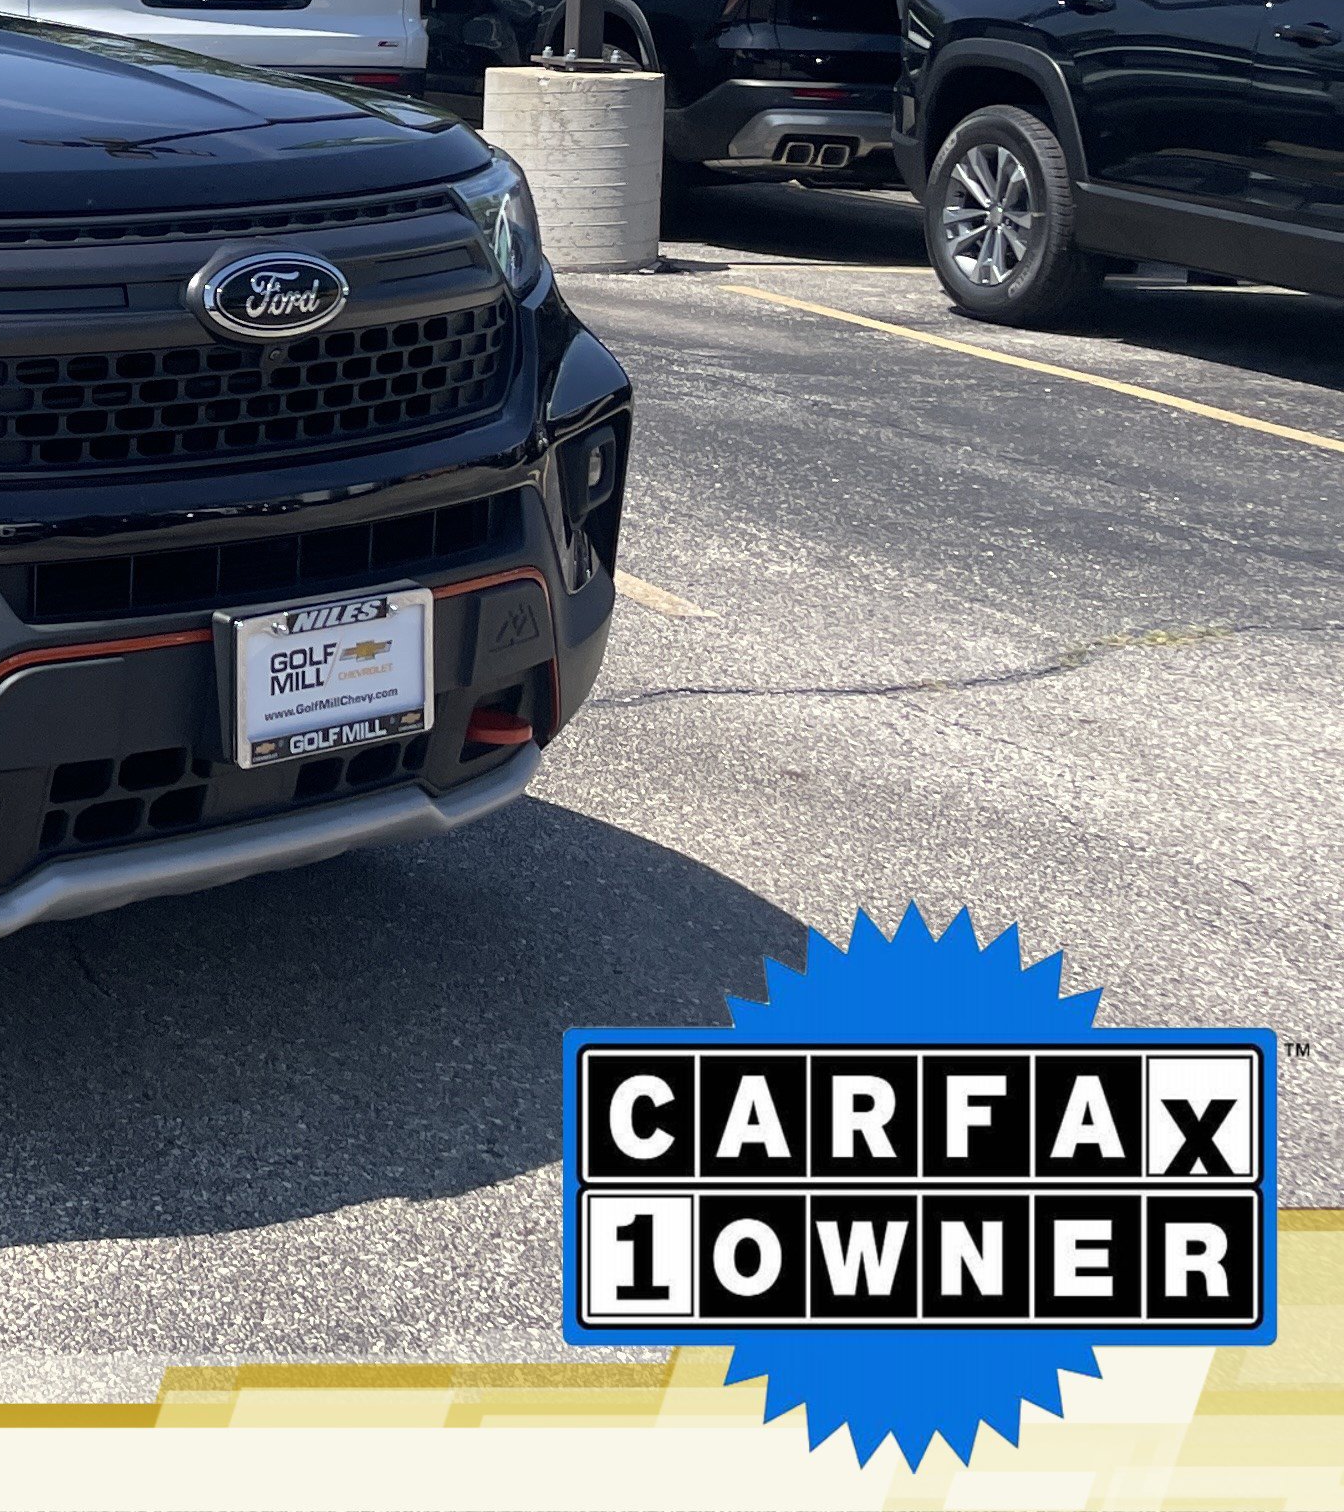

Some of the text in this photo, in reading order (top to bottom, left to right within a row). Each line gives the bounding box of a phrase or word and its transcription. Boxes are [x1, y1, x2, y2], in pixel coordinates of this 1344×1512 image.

[245, 271, 320, 318] Ford
[292, 599, 382, 634] NILES
[270, 642, 337, 674] GOLF
[270, 667, 325, 696] MILL
[264, 687, 399, 722] www.GolfMillChevy.com
[289, 719, 388, 754] GOLF MILL
